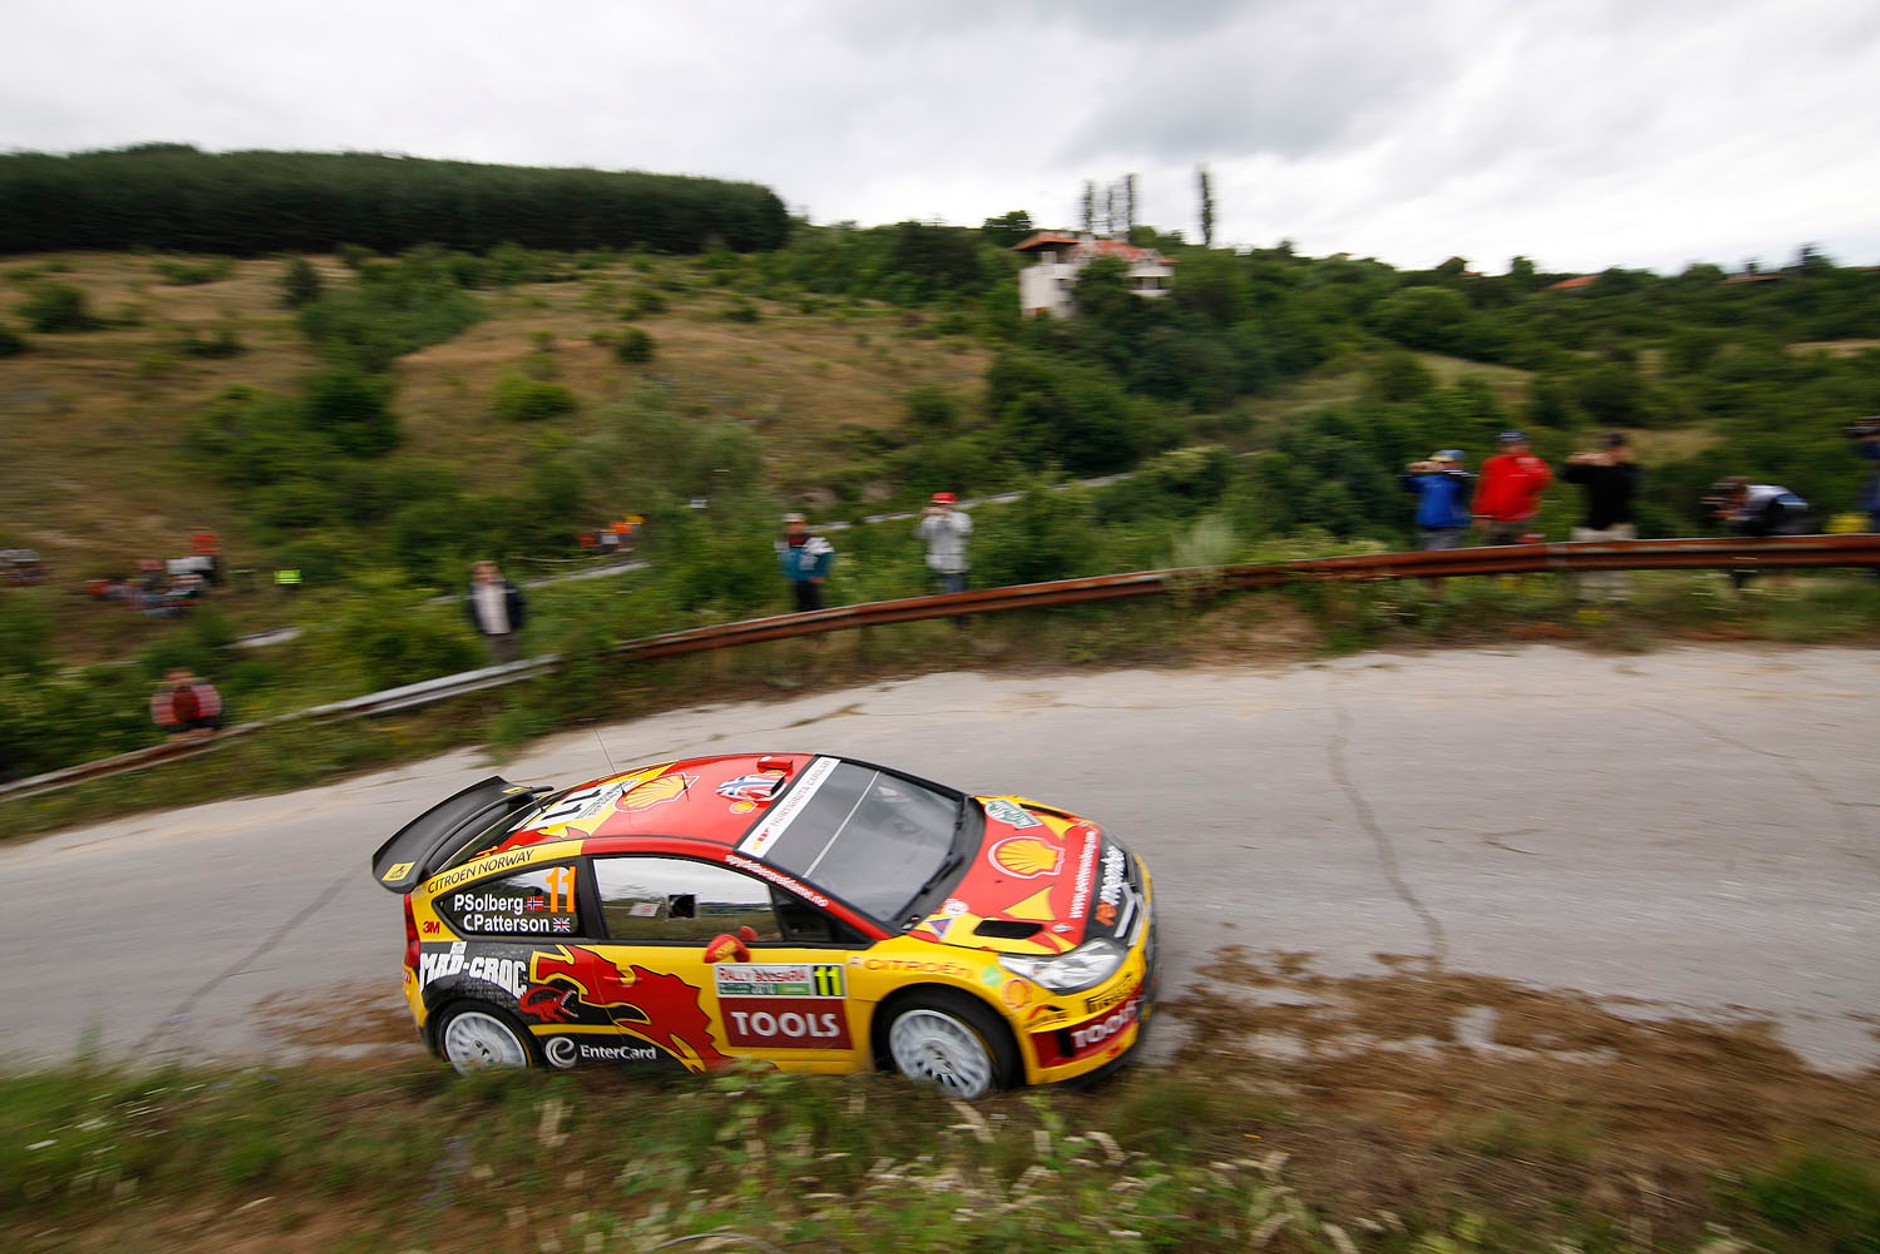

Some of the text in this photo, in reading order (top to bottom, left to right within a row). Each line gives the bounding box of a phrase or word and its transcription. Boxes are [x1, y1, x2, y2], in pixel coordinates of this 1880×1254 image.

[478, 849, 535, 875] NORWAY
[545, 866, 577, 914] 11
[422, 920, 441, 934] 3M
[419, 952, 529, 998] MAD-CROC
[814, 966, 842, 997] 11
[730, 1011, 841, 1038] TOOLS
[580, 1044, 657, 1060] EnterCard
